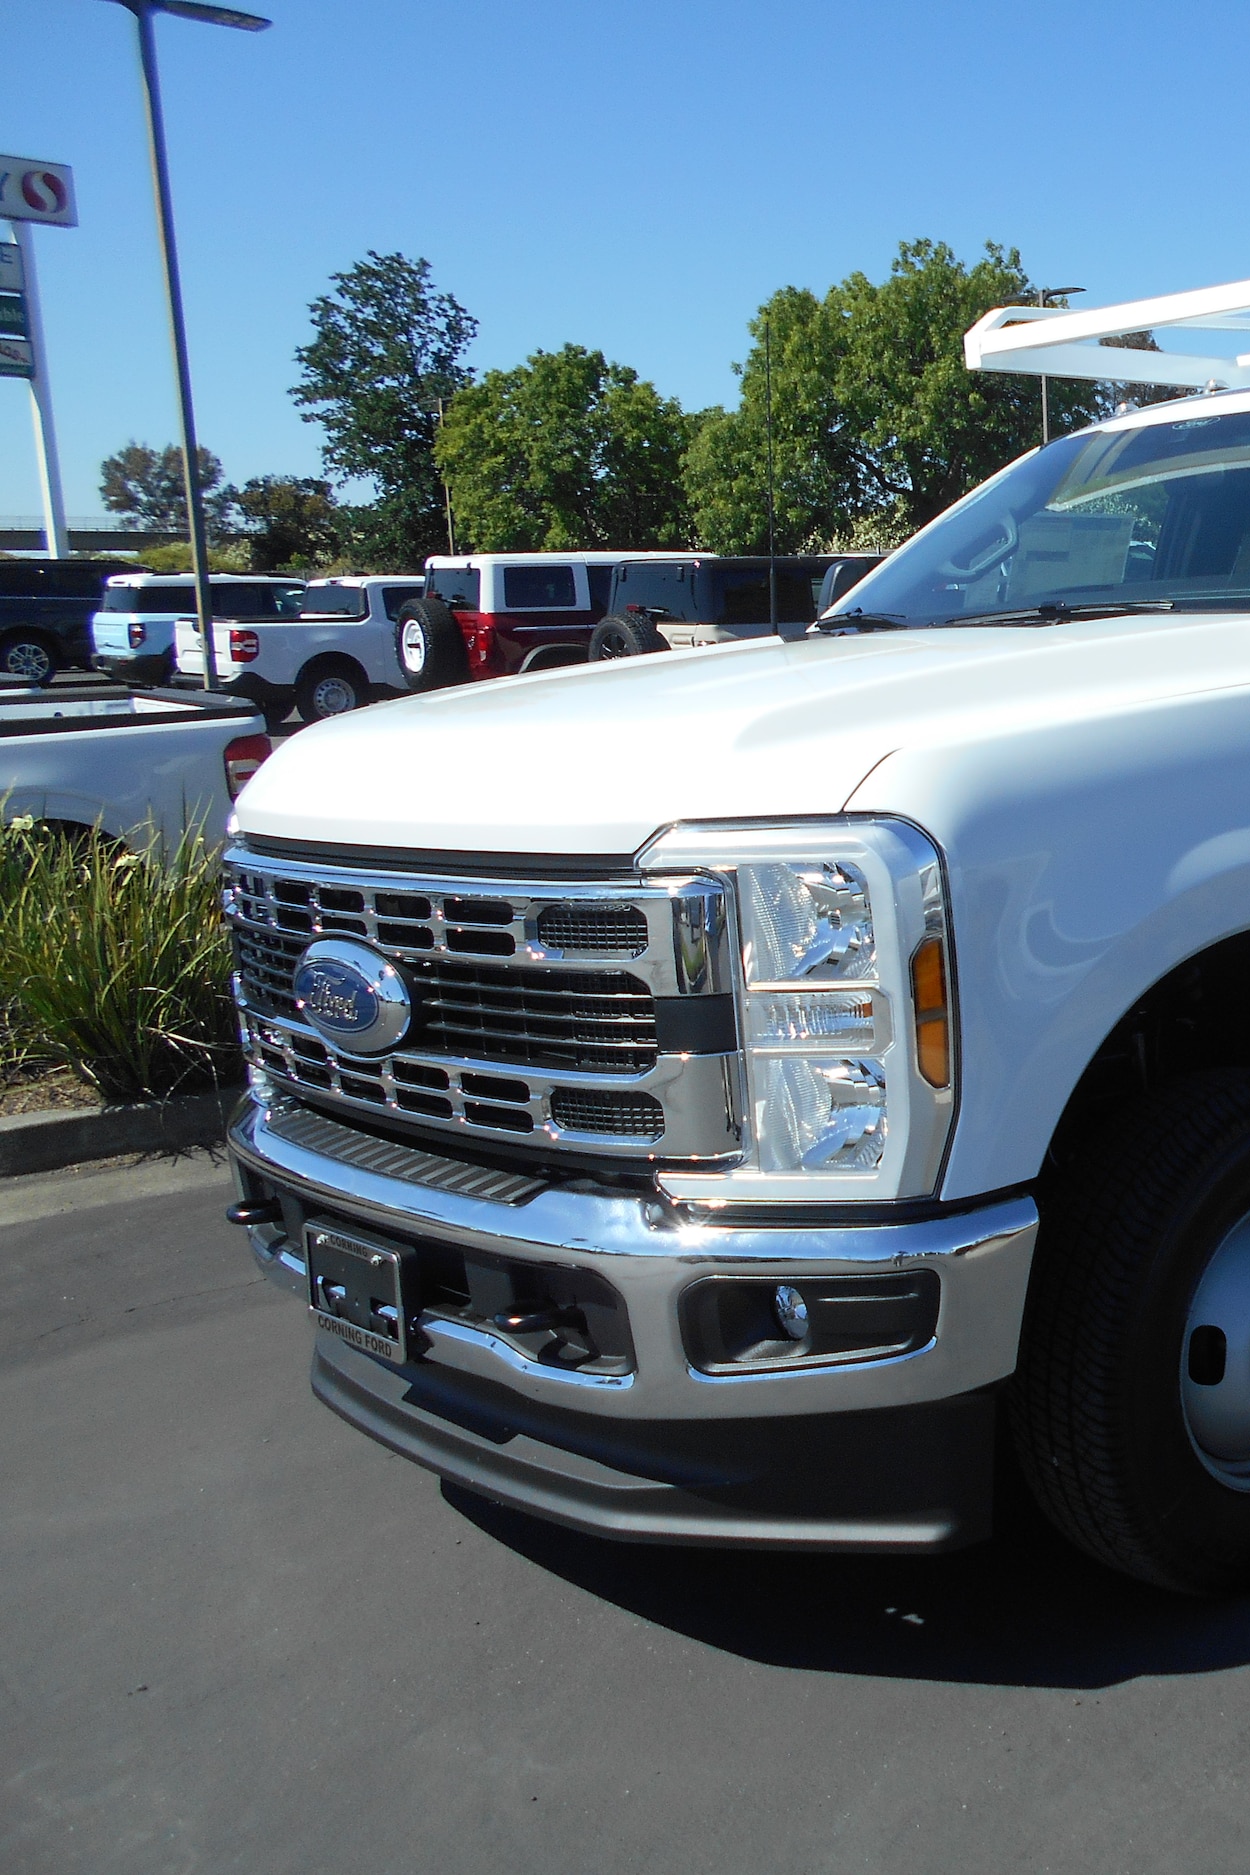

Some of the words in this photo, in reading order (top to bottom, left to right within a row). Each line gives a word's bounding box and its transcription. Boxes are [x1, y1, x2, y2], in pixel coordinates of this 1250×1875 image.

[330, 1234, 368, 1257] CORNING
[317, 1315, 363, 1345] CORNING
[365, 1337, 392, 1358] FORD
